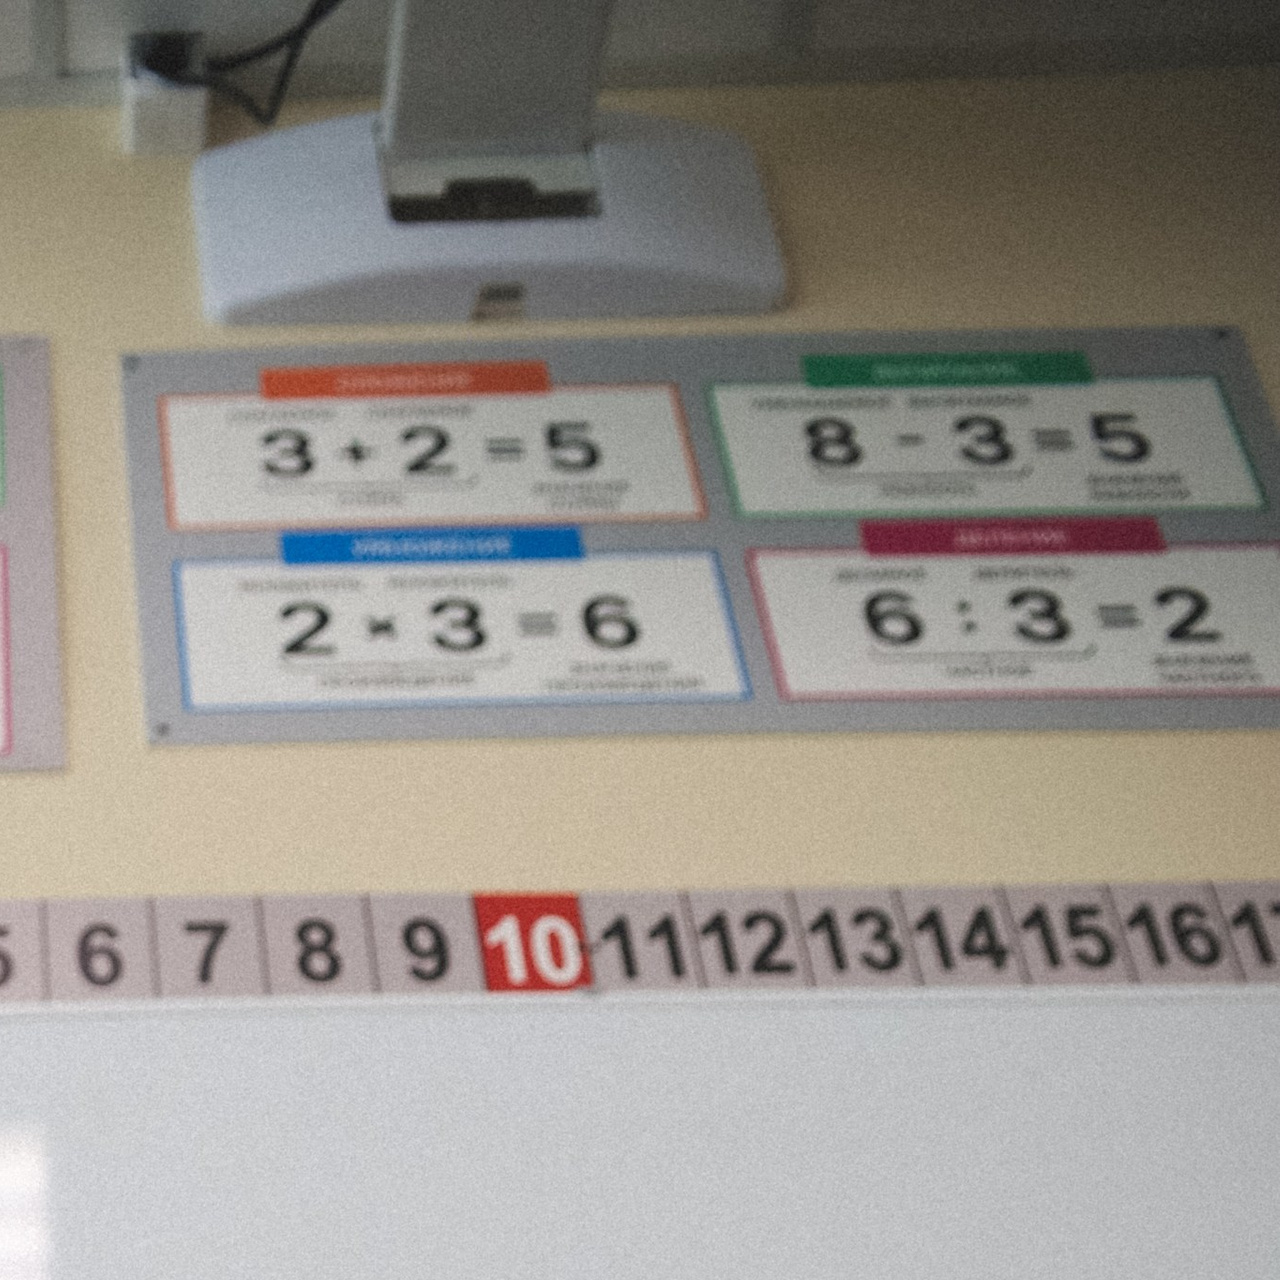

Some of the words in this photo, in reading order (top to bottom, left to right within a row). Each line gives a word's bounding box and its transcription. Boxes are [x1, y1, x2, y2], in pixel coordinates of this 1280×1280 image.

[261, 427, 314, 477] 3
[400, 425, 457, 475] 2
[486, 435, 527, 462] =
[544, 420, 601, 473] 5
[804, 417, 862, 467] 8
[953, 415, 1013, 466] 3
[1032, 427, 1075, 453] =
[1088, 411, 1151, 463] 5
[279, 600, 336, 656] 2
[431, 598, 487, 652] 3
[519, 610, 558, 636] =
[583, 594, 641, 649] 6
[864, 590, 923, 645] 6
[1007, 589, 1072, 644] 3
[1096, 601, 1143, 629] =
[1156, 586, 1222, 644] 2
[76, 923, 122, 986] 6
[184, 920, 229, 983] 7
[296, 918, 343, 982] 8
[403, 917, 451, 982] 9
[485, 914, 586, 987] 10
[603, 915, 687, 980] 11
[701, 912, 795, 975] 12
[809, 907, 904, 973] 13
[917, 905, 1009, 971] 14
[1021, 903, 1117, 970] 15
[1128, 902, 1222, 968] 16
[1232, 900, 1280, 968] 1
